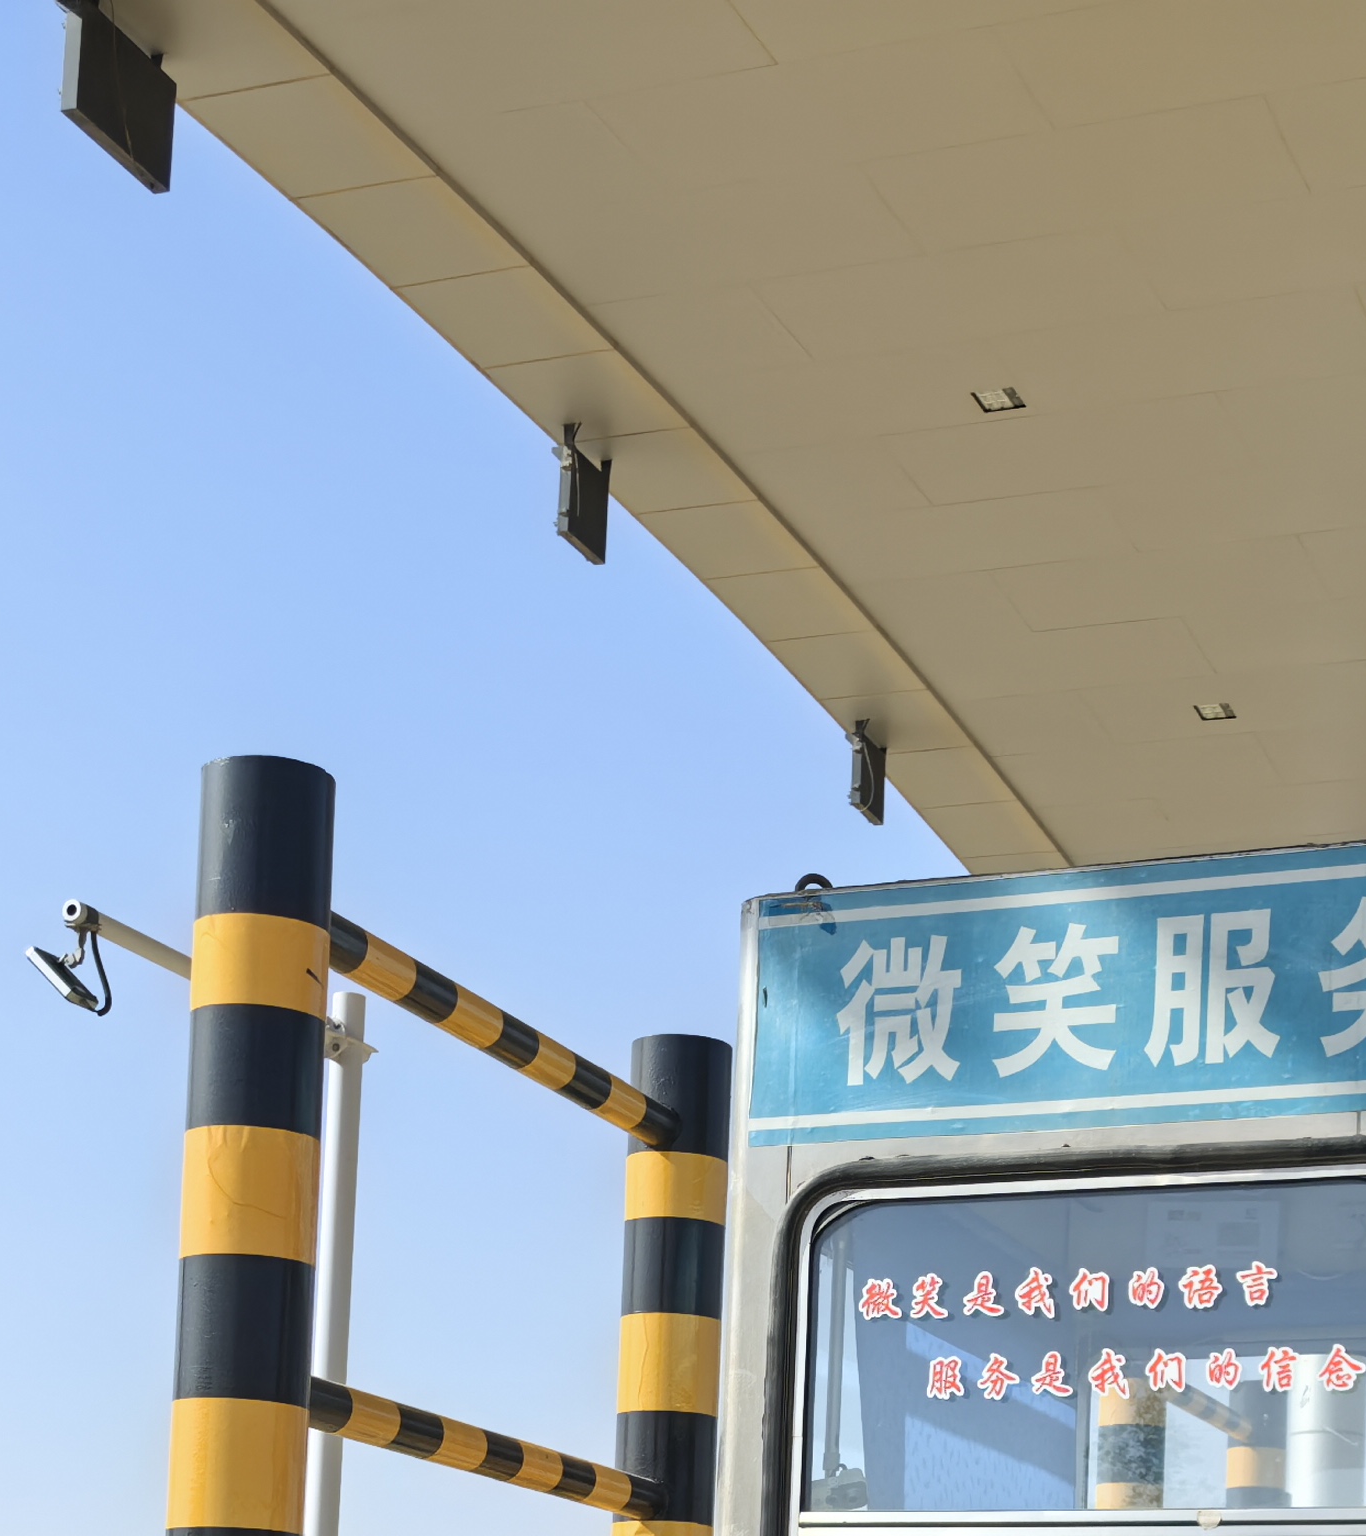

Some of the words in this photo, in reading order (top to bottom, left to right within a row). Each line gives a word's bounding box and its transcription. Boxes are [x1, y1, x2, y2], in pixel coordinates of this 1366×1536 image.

[858, 1261, 1280, 1321] 微笑是我们的语言
[926, 1343, 1366, 1400] 服务是我们的信念
